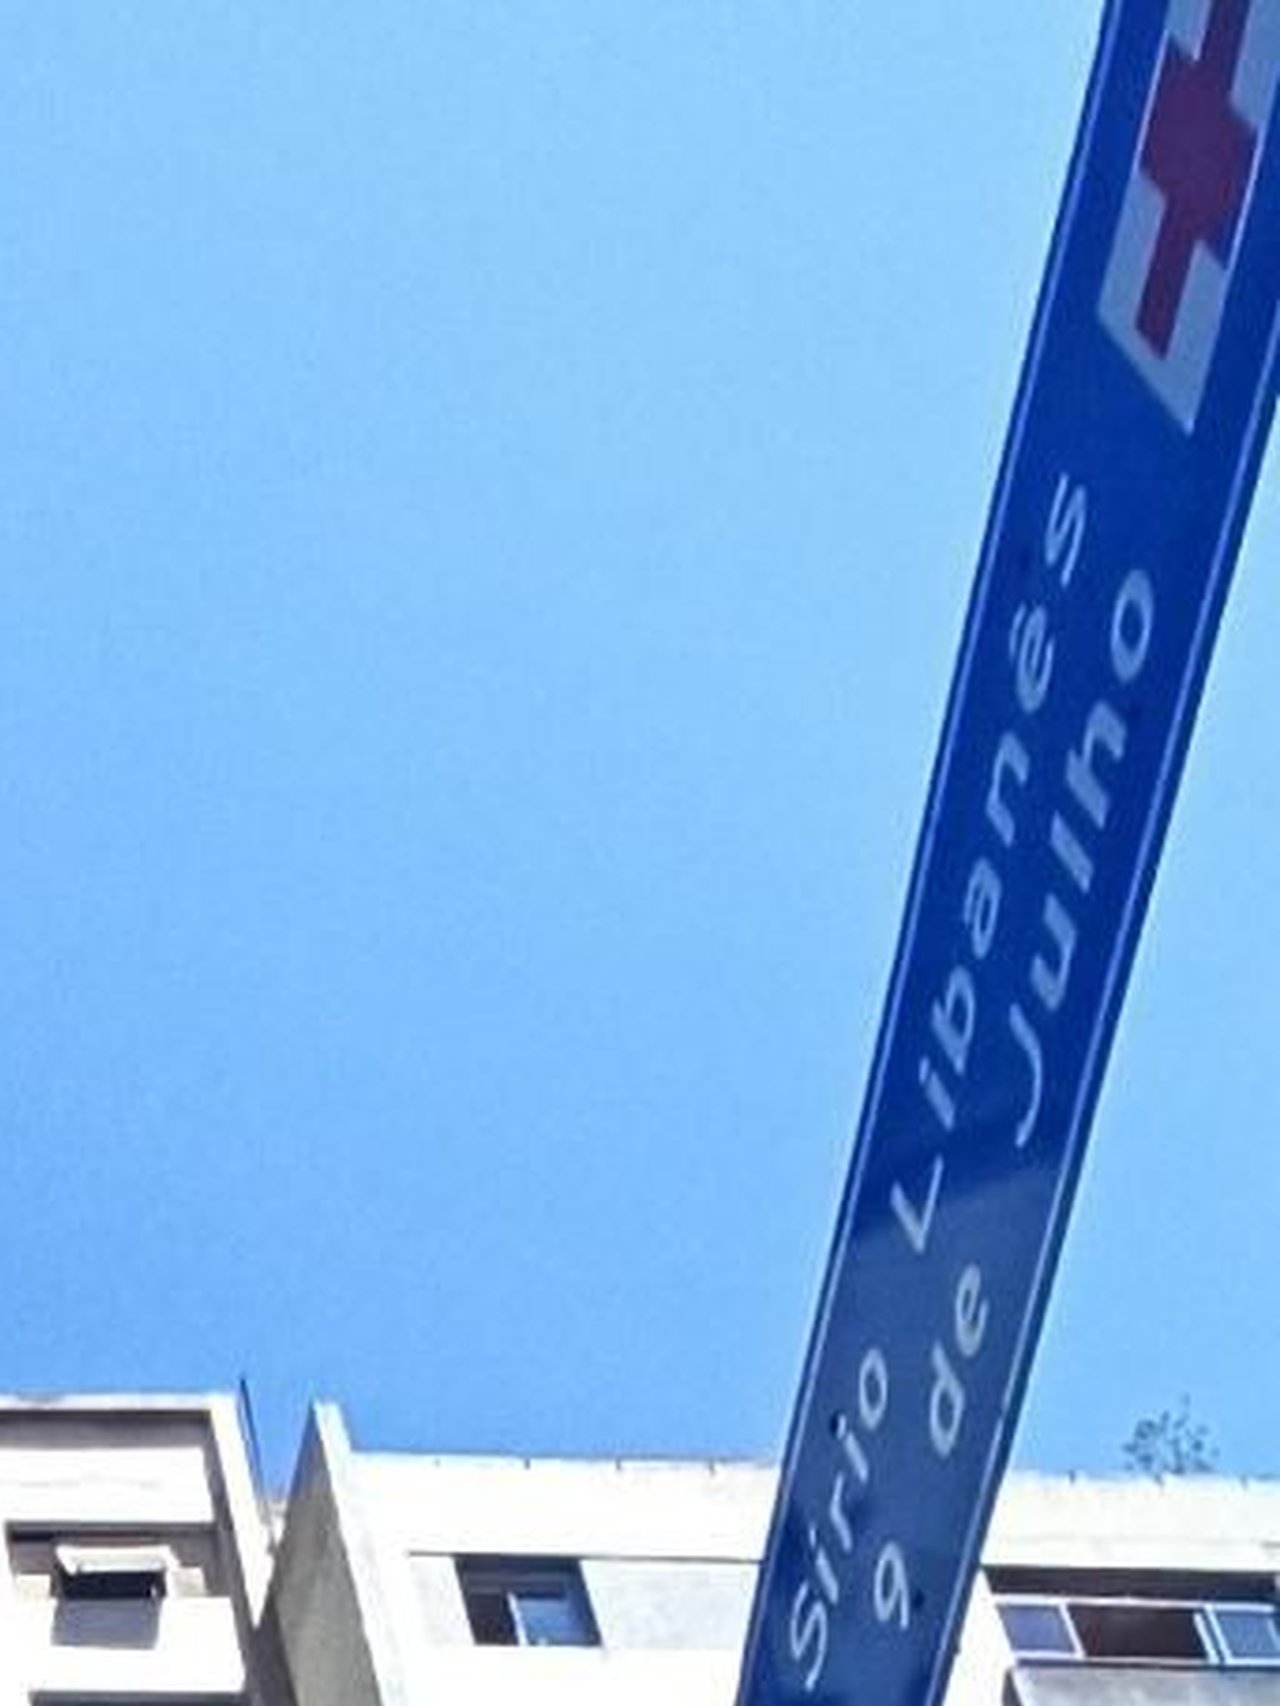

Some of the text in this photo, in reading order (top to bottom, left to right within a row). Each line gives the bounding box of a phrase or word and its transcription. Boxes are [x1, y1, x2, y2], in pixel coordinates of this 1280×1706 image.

[873, 1541, 909, 1631] 9
[929, 1263, 989, 1459] de
[1008, 567, 1155, 1150] Julho
[891, 471, 1088, 1254] Libanês
